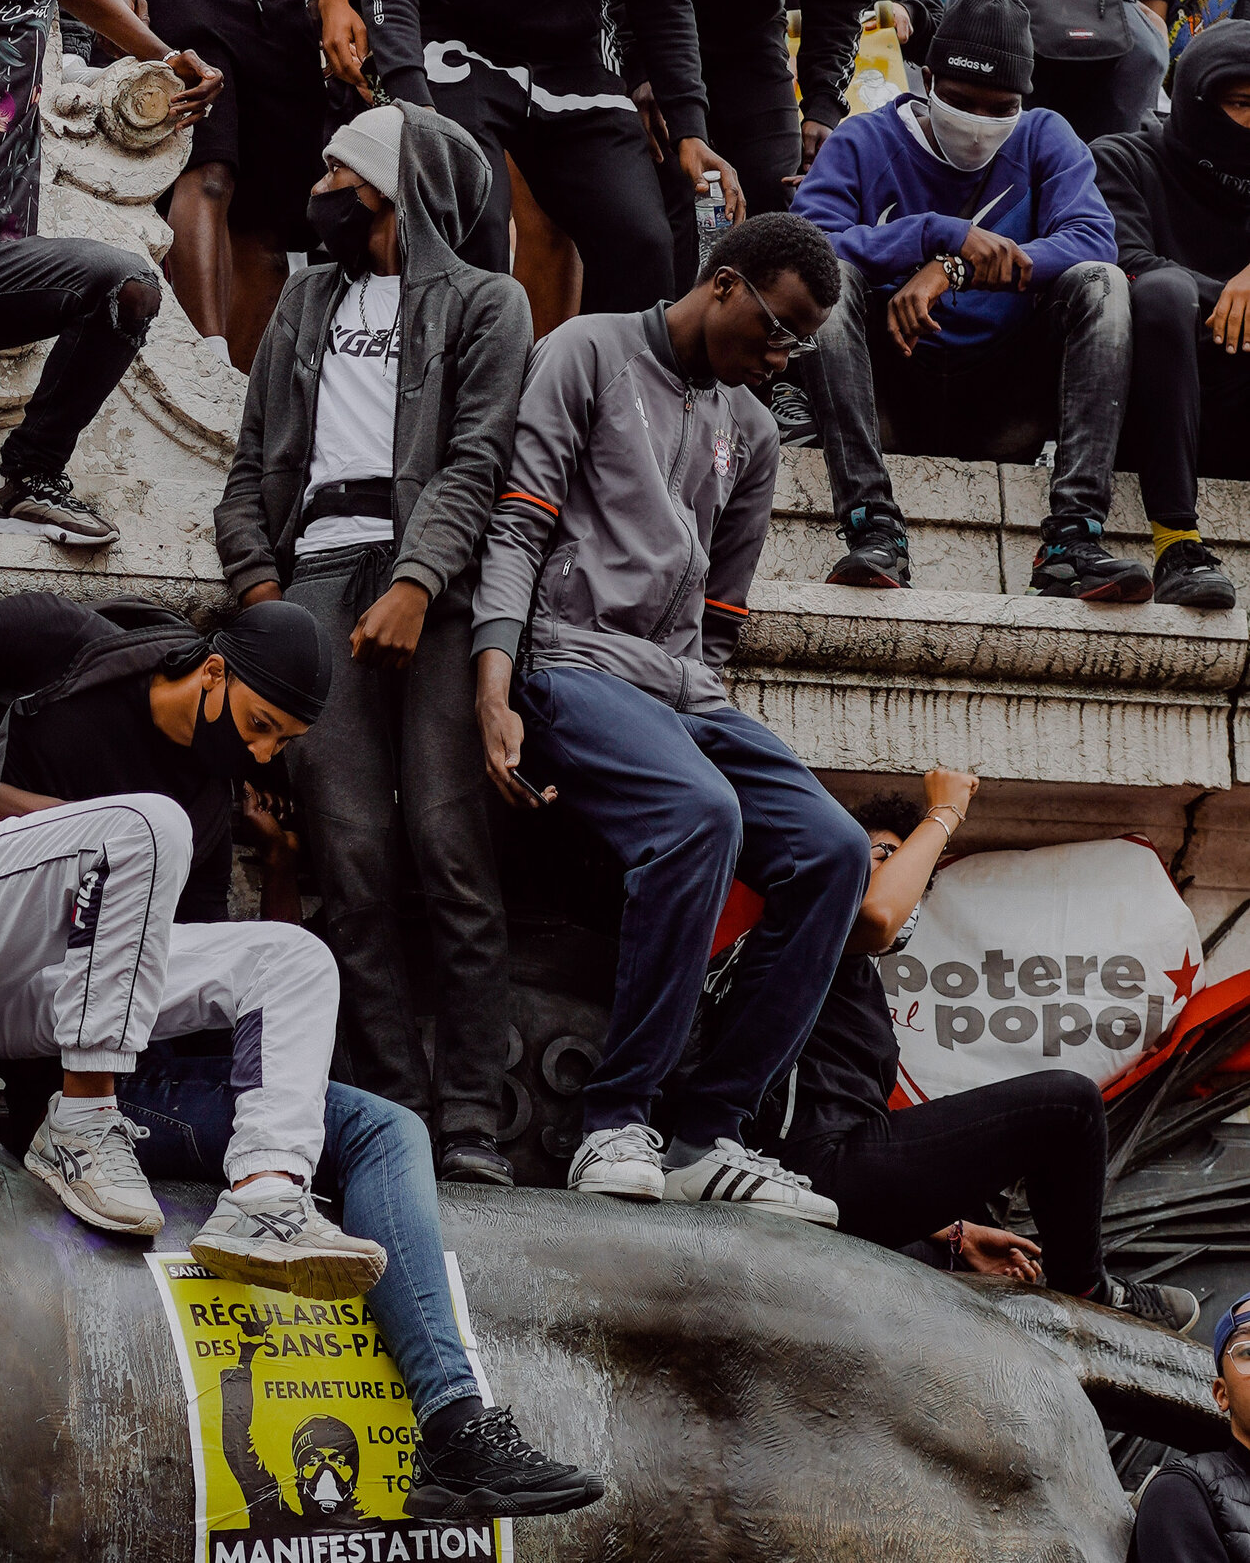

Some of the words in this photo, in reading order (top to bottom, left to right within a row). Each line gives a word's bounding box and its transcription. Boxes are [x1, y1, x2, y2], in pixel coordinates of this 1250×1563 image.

[947, 55, 980, 71] adidas
[71, 870, 99, 929] FILA
[880, 948, 1146, 1001] potere
[168, 1264, 216, 1280] SANT
[189, 1296, 378, 1327] RÉGULARISA
[196, 1340, 236, 1357] DES
[263, 1333, 393, 1358] SANS-PA
[263, 1381, 387, 1399] FERMETURE
[391, 1382, 409, 1400] D
[367, 1426, 421, 1444] LOGE
[383, 1474, 413, 1493] TO
[215, 1527, 492, 1563] MANIFESTATION
